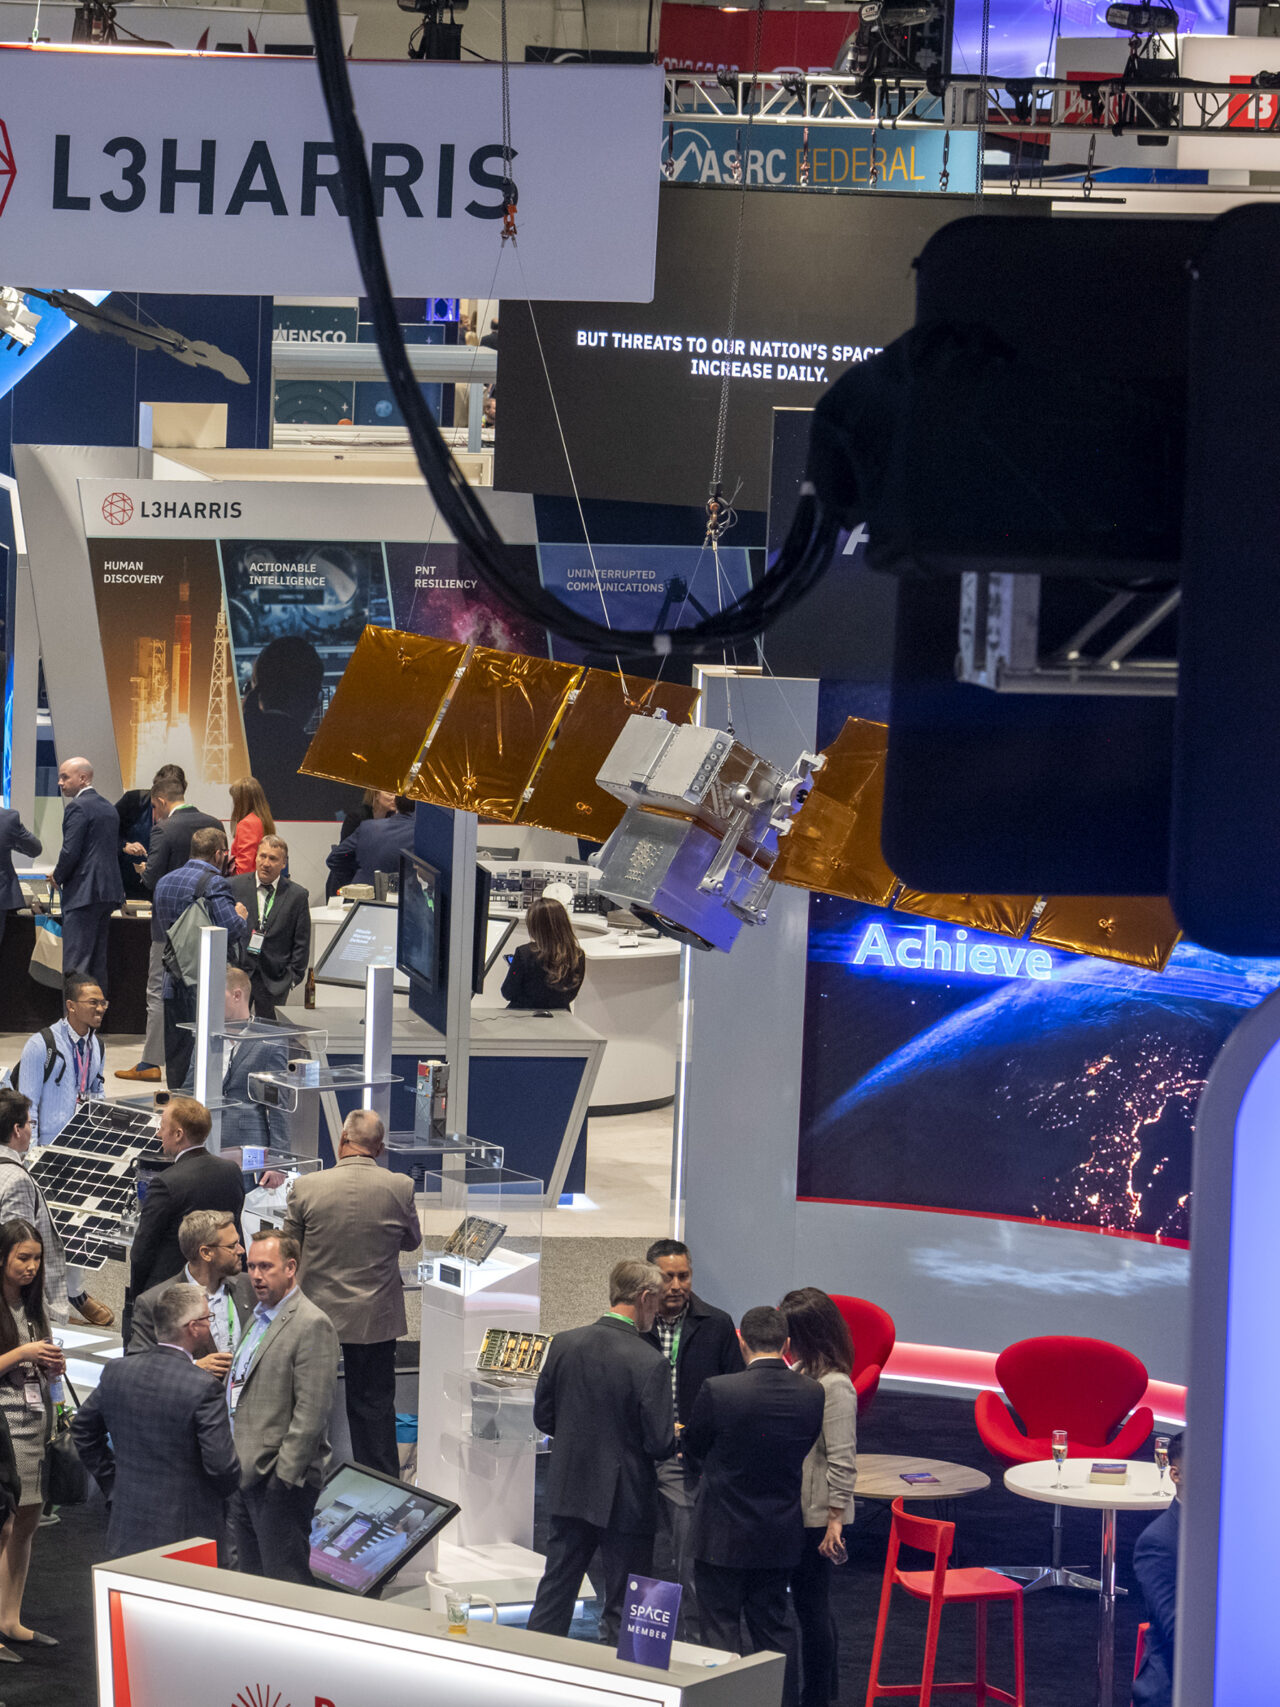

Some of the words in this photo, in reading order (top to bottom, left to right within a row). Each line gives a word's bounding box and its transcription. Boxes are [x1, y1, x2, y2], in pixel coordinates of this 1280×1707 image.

[699, 149, 787, 184] ASRC
[795, 146, 926, 183] FEDERAL
[52, 134, 519, 220] L3HARRIS
[288, 329, 347, 343] ENSCO
[576, 330, 608, 347] BUT
[612, 333, 683, 352] THREATS
[686, 337, 707, 353] TO
[712, 339, 745, 356] OUR
[750, 341, 827, 361] NATION'S
[690, 359, 772, 380] INCREASE
[777, 364, 829, 384] DAILY.
[140, 501, 242, 519] L3HARRIS
[104, 561, 144, 571] HUMAN
[249, 562, 317, 573] ACTIONABLE
[415, 565, 436, 575] PNT
[103, 574, 164, 585] DISCOVERY
[248, 575, 326, 586] INTELLIGENCE
[567, 568, 656, 580] UNINTERRUPTED
[414, 578, 478, 589] RESILIENCY
[566, 581, 665, 593] COMMUNICATIONS
[853, 923, 1053, 980] Achieve
[629, 1604, 671, 1624] SPACE
[627, 1624, 667, 1640] MEMBER
